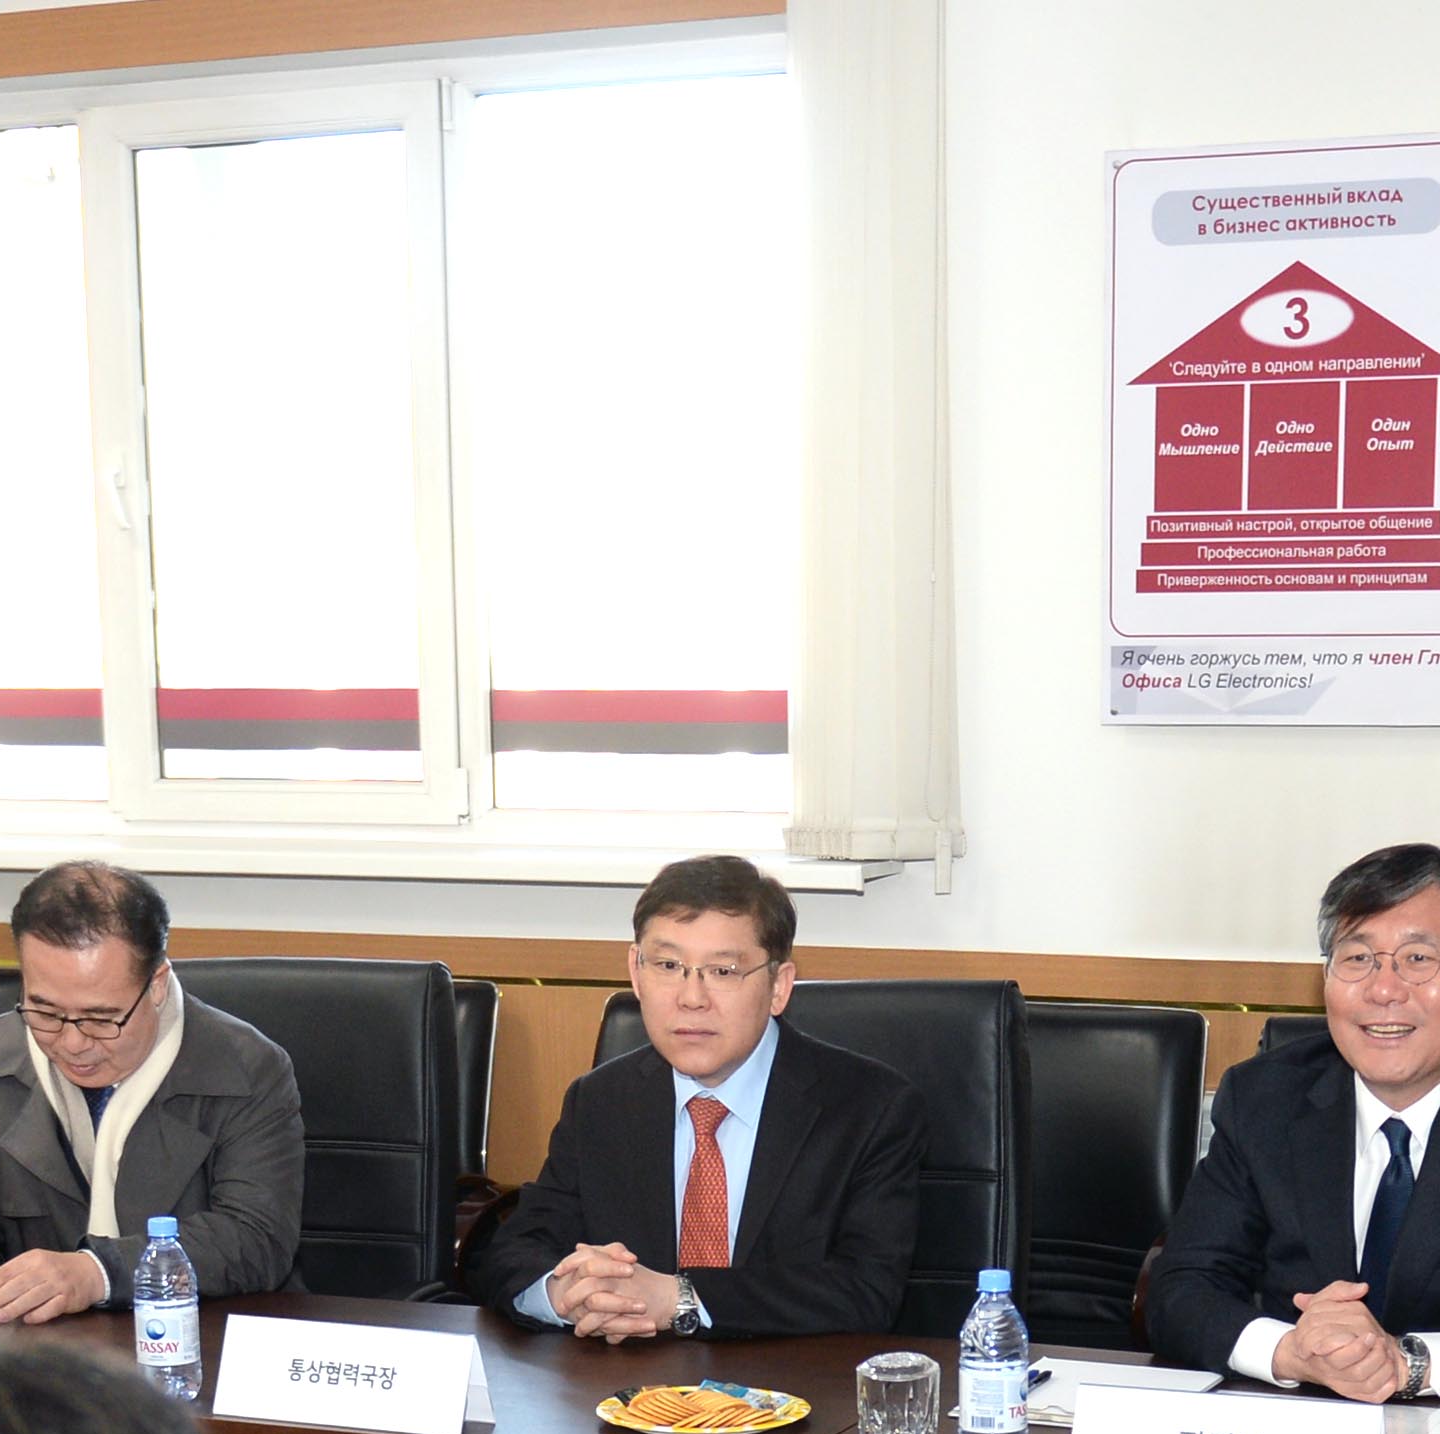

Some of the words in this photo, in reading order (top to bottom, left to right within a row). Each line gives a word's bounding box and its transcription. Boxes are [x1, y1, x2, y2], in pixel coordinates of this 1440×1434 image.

[1192, 188, 1343, 214] Существенный
[1347, 189, 1403, 203] вклад
[1198, 223, 1207, 236] в
[1213, 218, 1280, 235] бизнес
[1286, 213, 1396, 231] активность
[1284, 297, 1309, 340] 3
[1251, 361, 1261, 374] в
[1264, 359, 1314, 376] одном
[1181, 423, 1219, 437] Одно
[1276, 420, 1314, 434] Одно
[1371, 418, 1411, 432] Один
[1159, 442, 1241, 456] Мышление
[1255, 440, 1333, 456] Действие
[1367, 437, 1414, 451] Опыт
[1151, 518, 1233, 533] Позитивный
[1237, 517, 1296, 533] настрой,
[1301, 519, 1365, 532] открытое
[1369, 515, 1432, 530] общение
[1198, 545, 1334, 562] Профессиональная
[1337, 543, 1386, 560] работа
[1158, 572, 1272, 589] Приверженность
[1275, 574, 1334, 585] основам
[1338, 573, 1346, 585] и
[1350, 573, 1427, 587] принципам
[1120, 650, 1135, 666] Я
[1137, 654, 1186, 666] очень
[1190, 653, 1260, 670] горжусь
[1264, 653, 1306, 667] тем,
[1313, 653, 1347, 666] что
[1352, 653, 1363, 665] я
[1369, 653, 1413, 665] член
[1122, 673, 1182, 692] Офиса
[1188, 673, 1211, 688] LG
[1216, 673, 1313, 688] Electronics!
[139, 1340, 180, 1354] TASSAY
[288, 1358, 397, 1391] 통상협력국장
